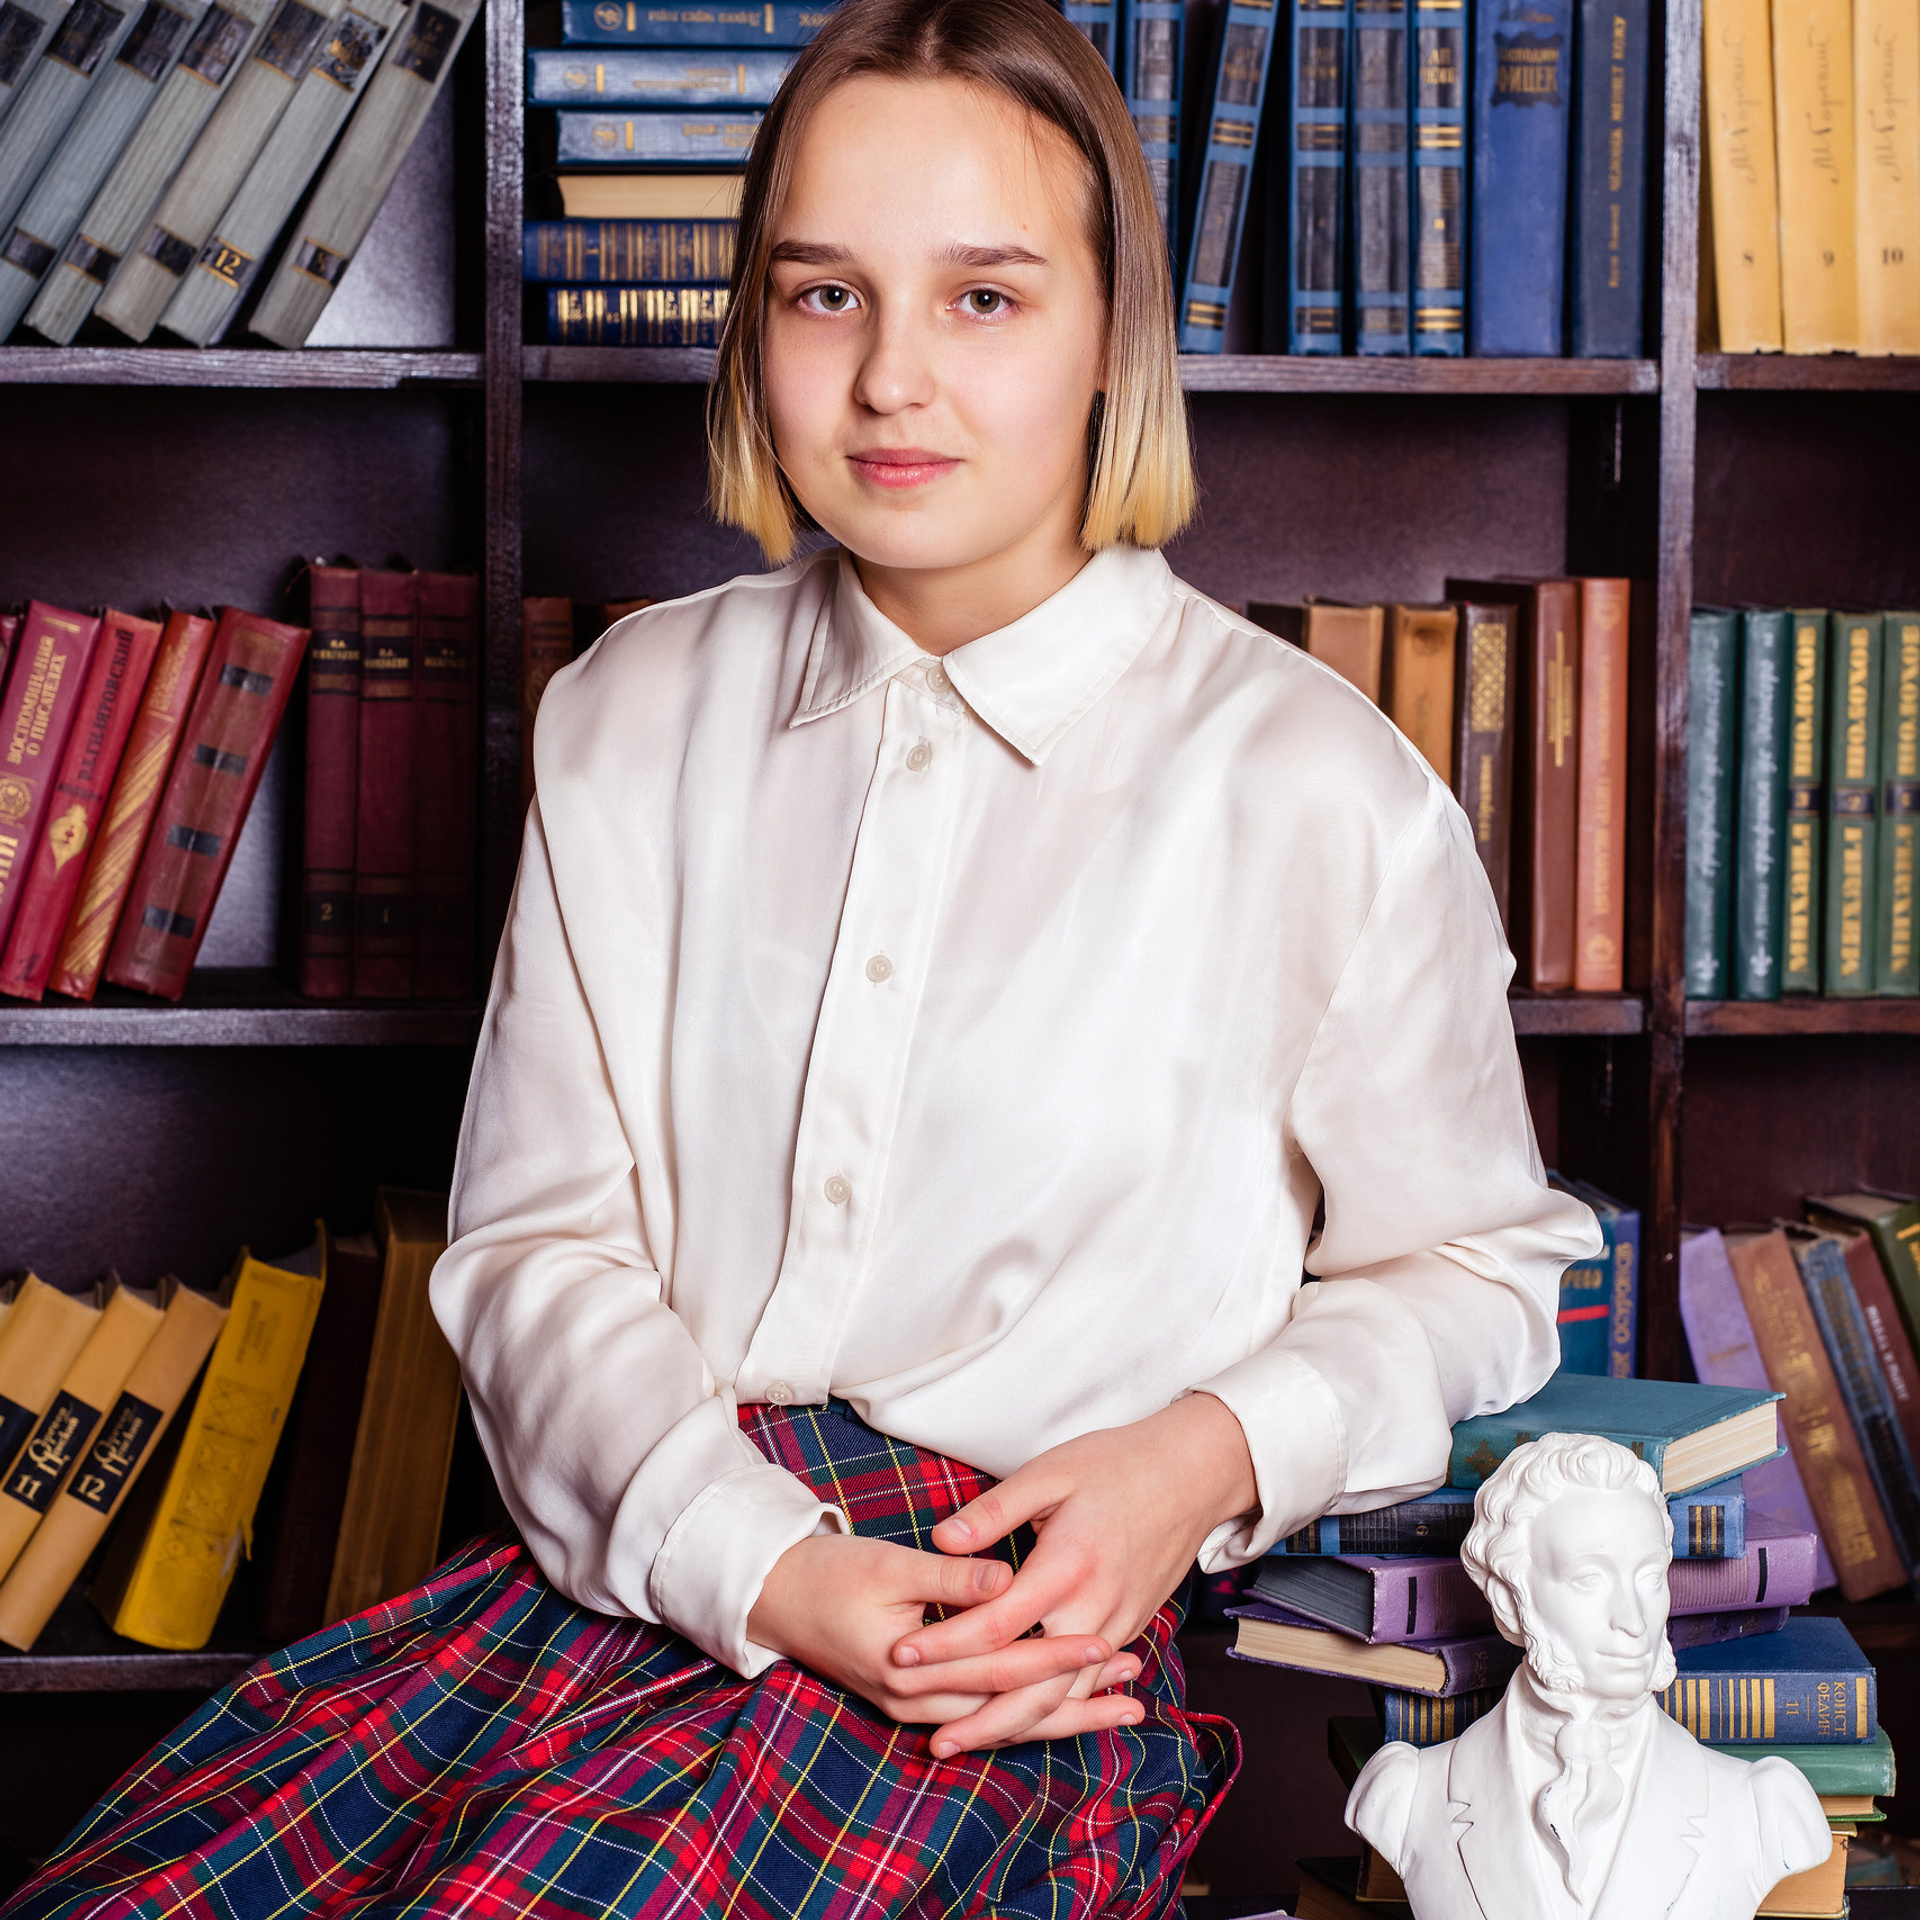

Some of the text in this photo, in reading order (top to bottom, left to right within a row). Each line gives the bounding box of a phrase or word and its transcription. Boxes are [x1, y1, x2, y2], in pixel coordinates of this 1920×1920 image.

[718, 10, 762, 28] Дорога
[214, 249, 241, 276] 12
[1742, 252, 1755, 268] 8
[1821, 250, 1834, 268] 9
[1881, 248, 1905, 265] 10
[7, 635, 56, 766] ВОСПОМИНАНИЯ
[25, 653, 68, 757] О ПИСАТЕЛЯХ
[1792, 625, 1817, 777] ШОЛОХОВ
[1845, 627, 1870, 779] ШОЛОХОВ
[1896, 625, 1920, 777] ШОЛОХОВ
[1754, 747, 1777, 775] де
[319, 902, 333, 922] 2
[13, 1473, 43, 1502] 11
[76, 1473, 106, 1502] 12
[1786, 1701, 1799, 1716] 11
[1817, 1681, 1831, 1736] ФЕДИН
